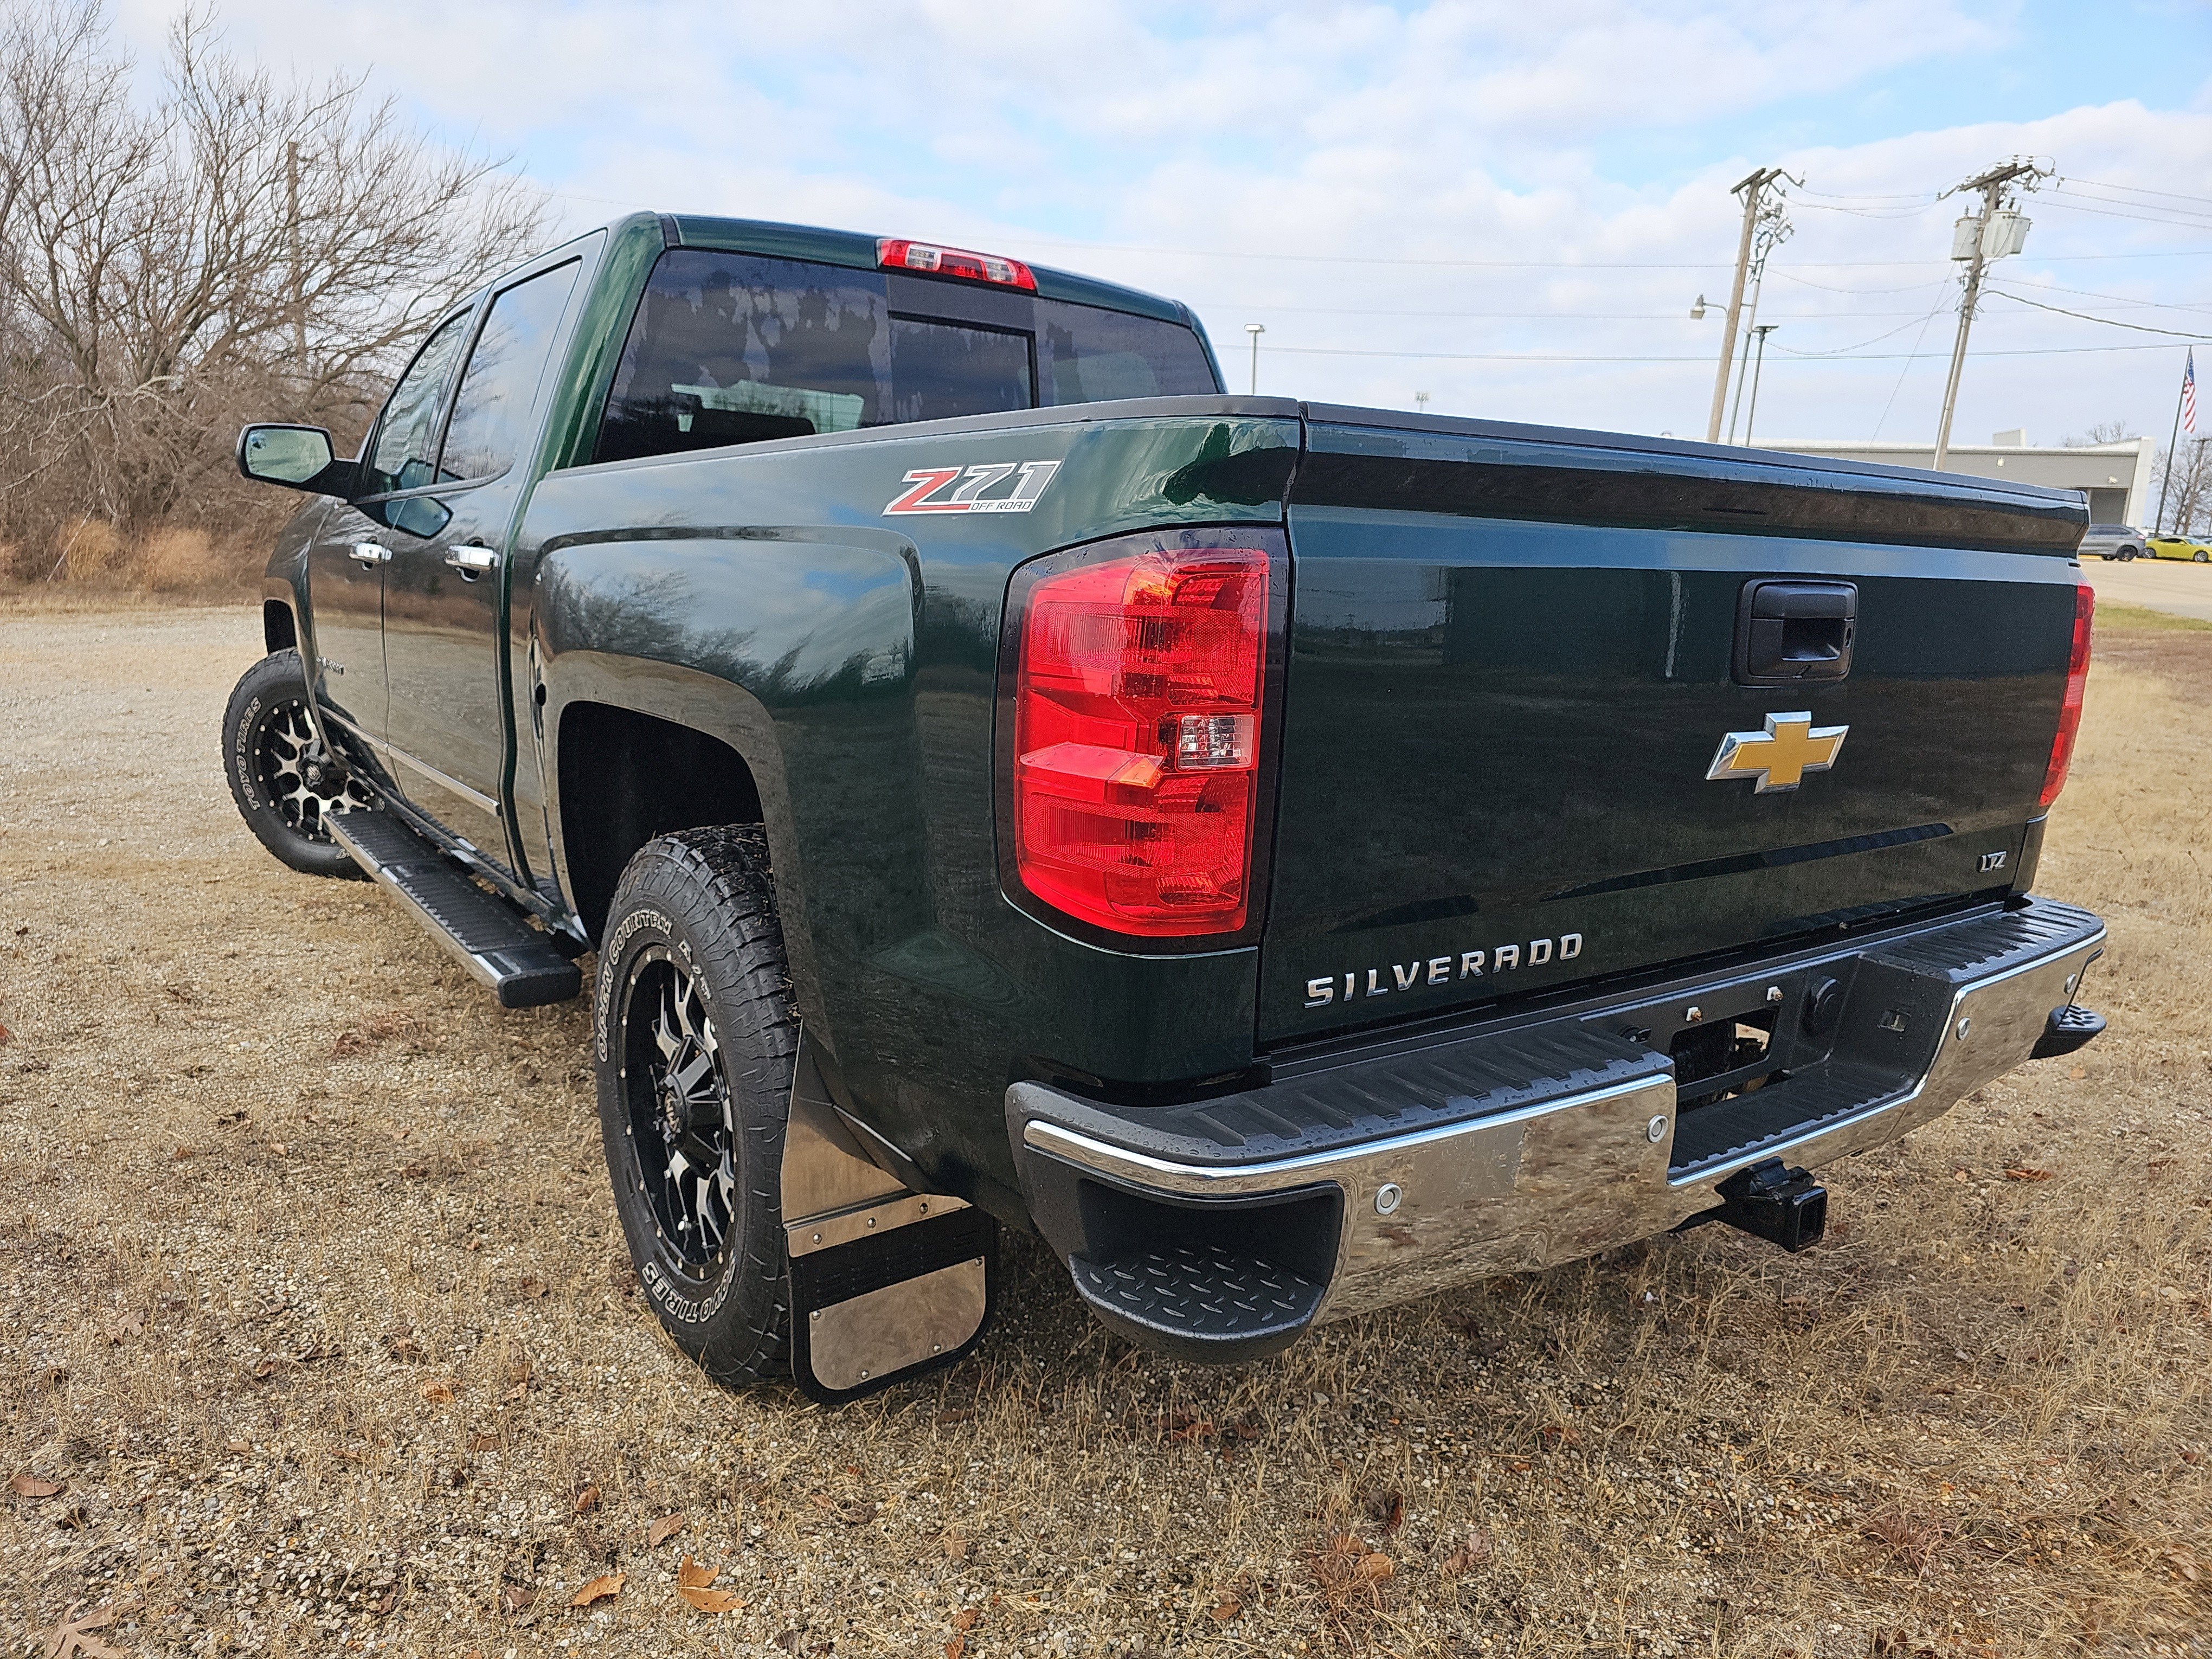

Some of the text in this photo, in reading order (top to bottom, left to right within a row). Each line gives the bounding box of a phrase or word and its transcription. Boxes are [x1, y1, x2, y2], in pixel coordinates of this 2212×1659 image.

[882, 459, 1065, 516] Z71
[970, 500, 1032, 510] OFF ROAD
[236, 697, 261, 810] TOYO TIRES
[1979, 851, 2007, 873] LTZ
[1304, 933, 1583, 1008] SILVERADO
[597, 961, 614, 1062] OPEN
[641, 1248, 736, 1323] TOYO TIRES
